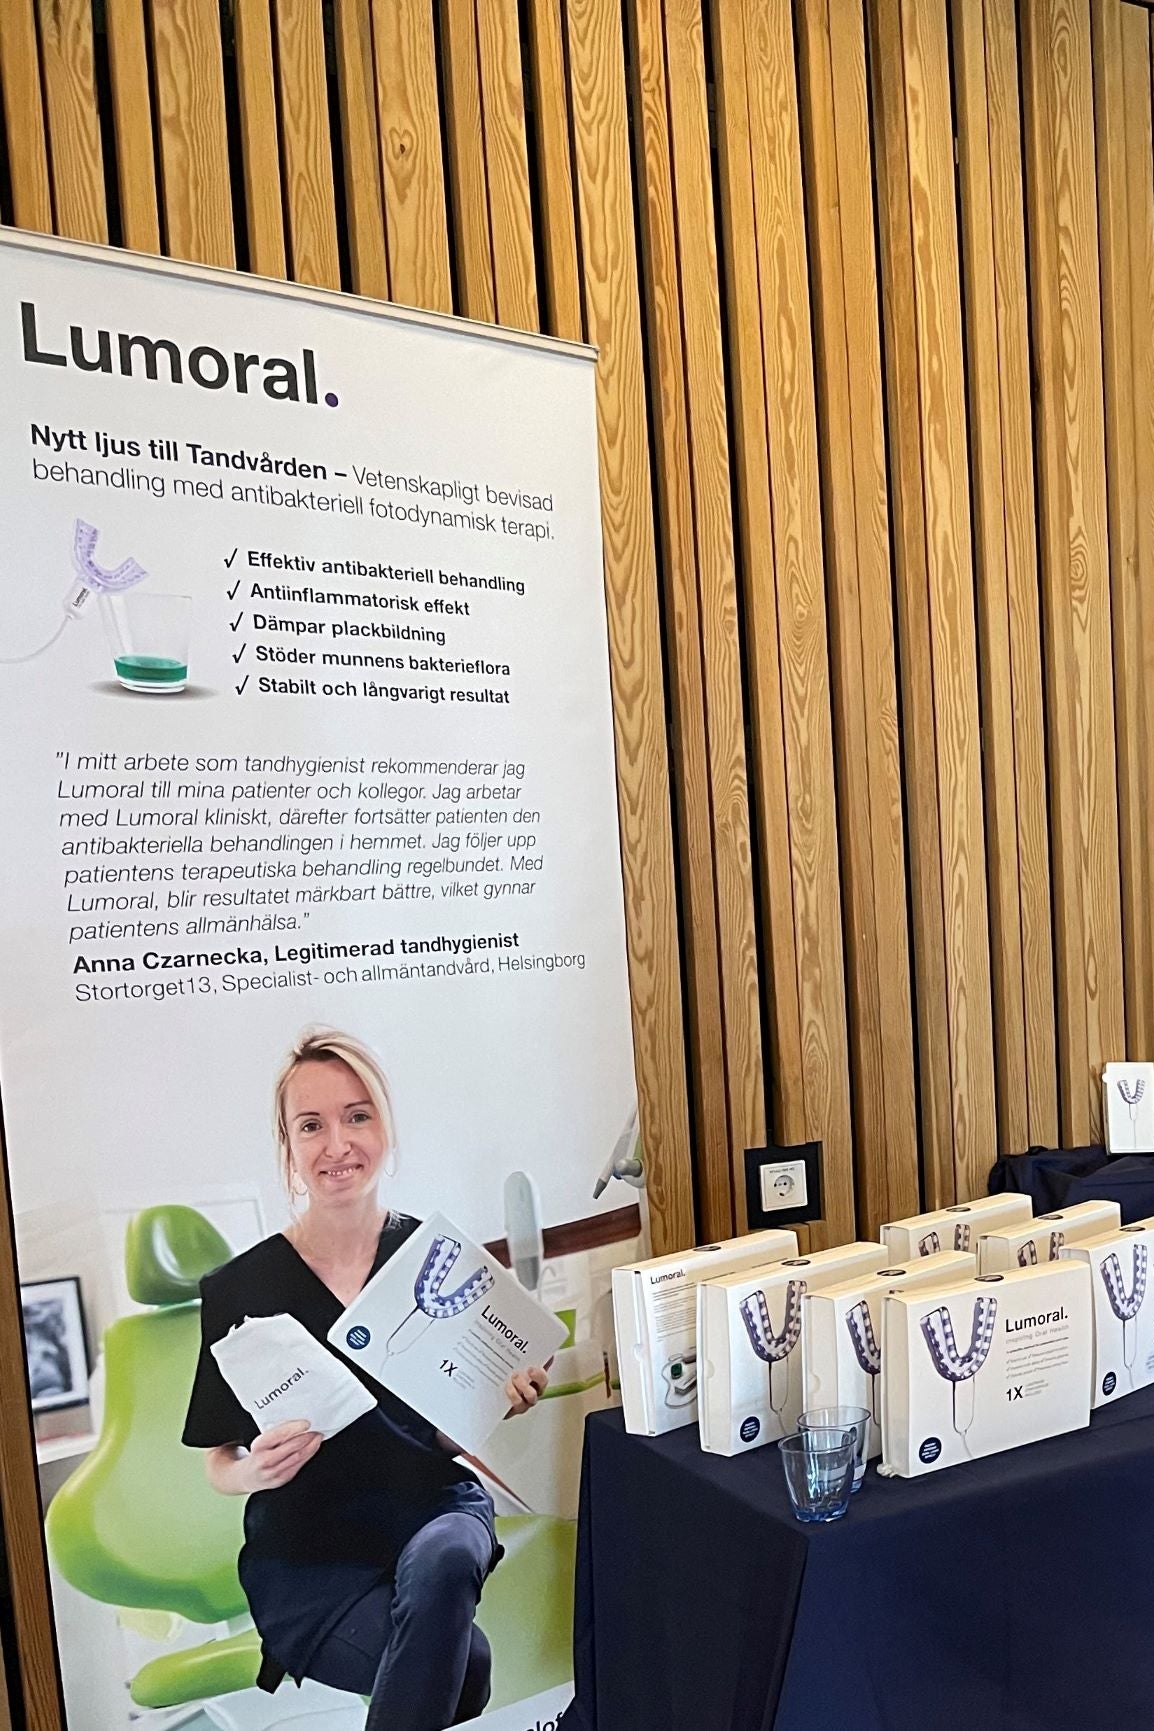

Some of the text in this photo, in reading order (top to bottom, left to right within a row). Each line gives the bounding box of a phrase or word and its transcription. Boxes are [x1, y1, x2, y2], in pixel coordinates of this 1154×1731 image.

[20, 300, 339, 408] Lumoral.
[30, 423, 87, 452] Nytt
[94, 431, 141, 457] ljus
[147, 439, 178, 461] till
[185, 443, 327, 479] Tandvården
[351, 466, 480, 504] Vetenskapligt
[485, 485, 553, 511] bevisad
[32, 458, 554, 541] behandling med antibakteriell fotodynamisk terapi.
[247, 550, 525, 595] Effektiv antibakteriell behandling
[249, 583, 470, 615] Antiinflammatorisk effekt
[252, 613, 445, 645] Dämpar plackbildning
[255, 645, 510, 675] Stöder munnens bakterieflora
[258, 676, 510, 703] Stabilt och långvarigt resultat
[76, 752, 117, 770] mitt
[123, 753, 189, 771] arbete
[194, 757, 238, 771] som
[244, 755, 365, 776] tandhygienist
[370, 758, 499, 775] rekommenderar
[501, 760, 525, 779] jag
[57, 780, 522, 803] Lumoral till mina patienter och kollegor. Jag arbetar
[59, 807, 540, 827] med Lumoral kliniskt, därefter fortsätter patienten den
[61, 832, 536, 855] antibakteriella behandlingen i hemmet. Jag följer upp
[63, 855, 543, 887] patientens terapeutiska behandling regelbundet. Med
[67, 881, 536, 911] Lumoral, blir resultatet märkbart bättre, vilket gynnar
[68, 920, 179, 943] patientens
[72, 932, 519, 973] Anna Czarnecka, Legitimerad tandhygienist
[221, 970, 319, 993] och
[323, 966, 357, 984] allmäntandvård,
[361, 957, 494, 981] allmäntandvård,
[497, 953, 586, 975] Helsingborg
[650, 1269, 686, 1285] Lumoral.
[481, 1304, 529, 1354] Lumoral.
[1005, 1306, 1068, 1332] Lumoral.
[439, 1359, 458, 1377] 1X
[254, 1367, 309, 1409] Lumoral.
[1006, 1385, 1024, 1402] 1X
